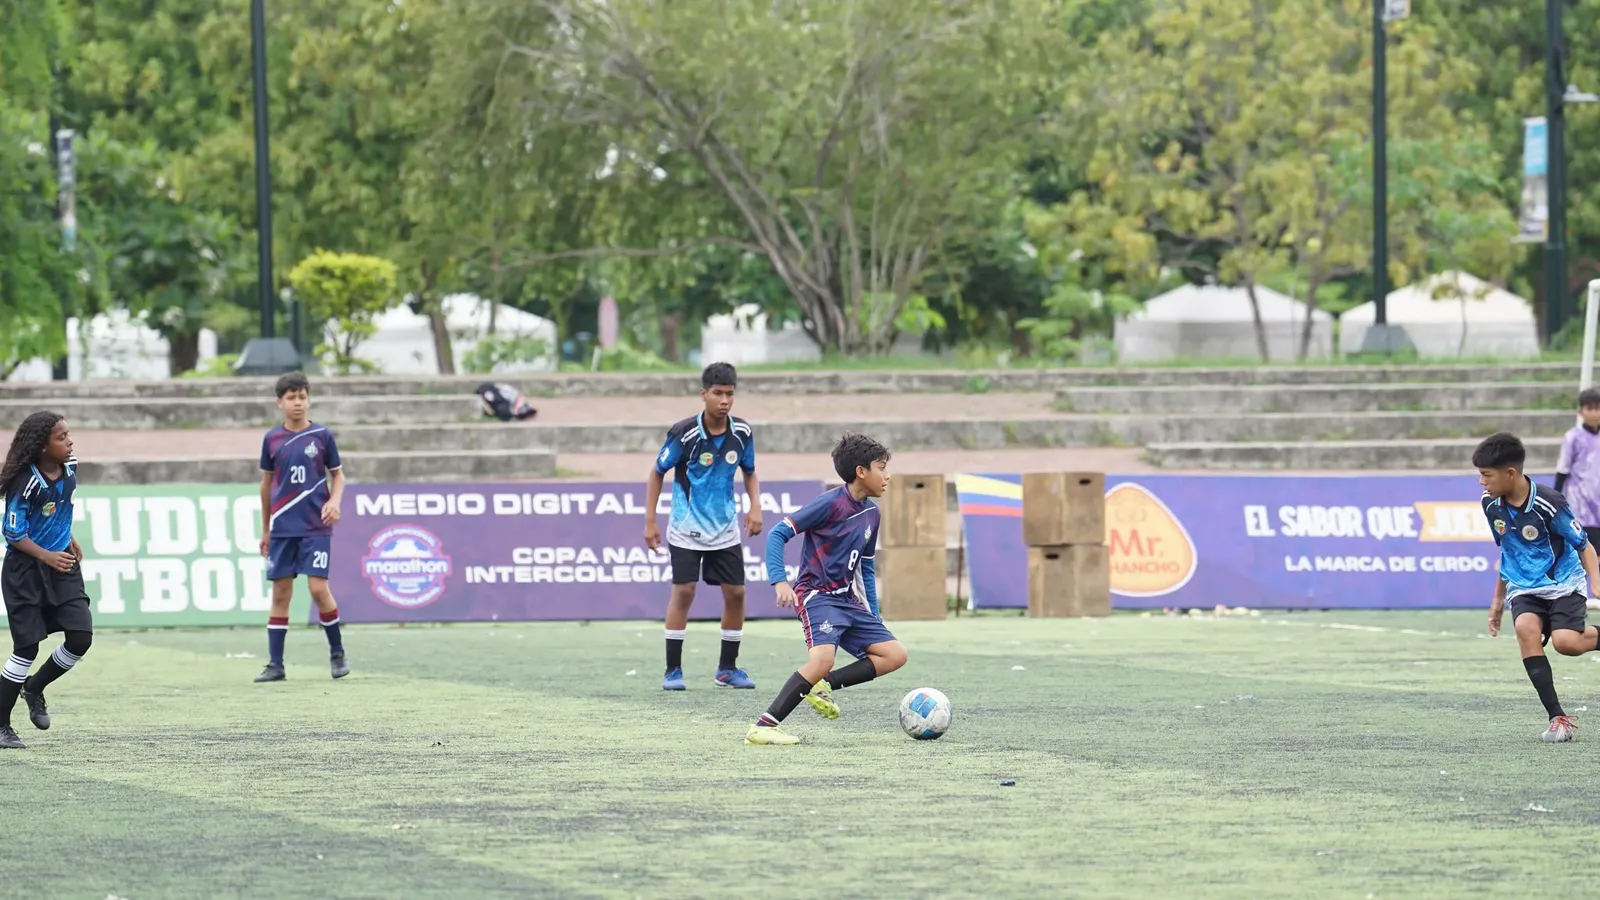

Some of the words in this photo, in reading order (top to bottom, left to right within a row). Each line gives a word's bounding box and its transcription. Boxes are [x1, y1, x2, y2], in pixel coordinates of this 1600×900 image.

[290, 465, 306, 484] 20
[355, 493, 486, 515] MEDIO
[493, 492, 647, 515] DIGITAL
[1244, 505, 1276, 537] EL
[1278, 505, 1366, 537] SABOR
[1366, 505, 1418, 541] QUE
[312, 551, 328, 569] 20
[512, 546, 599, 564] COPA
[847, 549, 859, 571] 8
[1284, 555, 1313, 572] LA
[1315, 556, 1387, 572] MARCA
[1388, 556, 1417, 572] DE
[1420, 556, 1489, 572] CERDO
[366, 558, 448, 575] marathon
[465, 565, 674, 583] INTERCOLEGIA
[1109, 562, 1180, 574] HANCHO
[80, 557, 273, 612] TBOL
